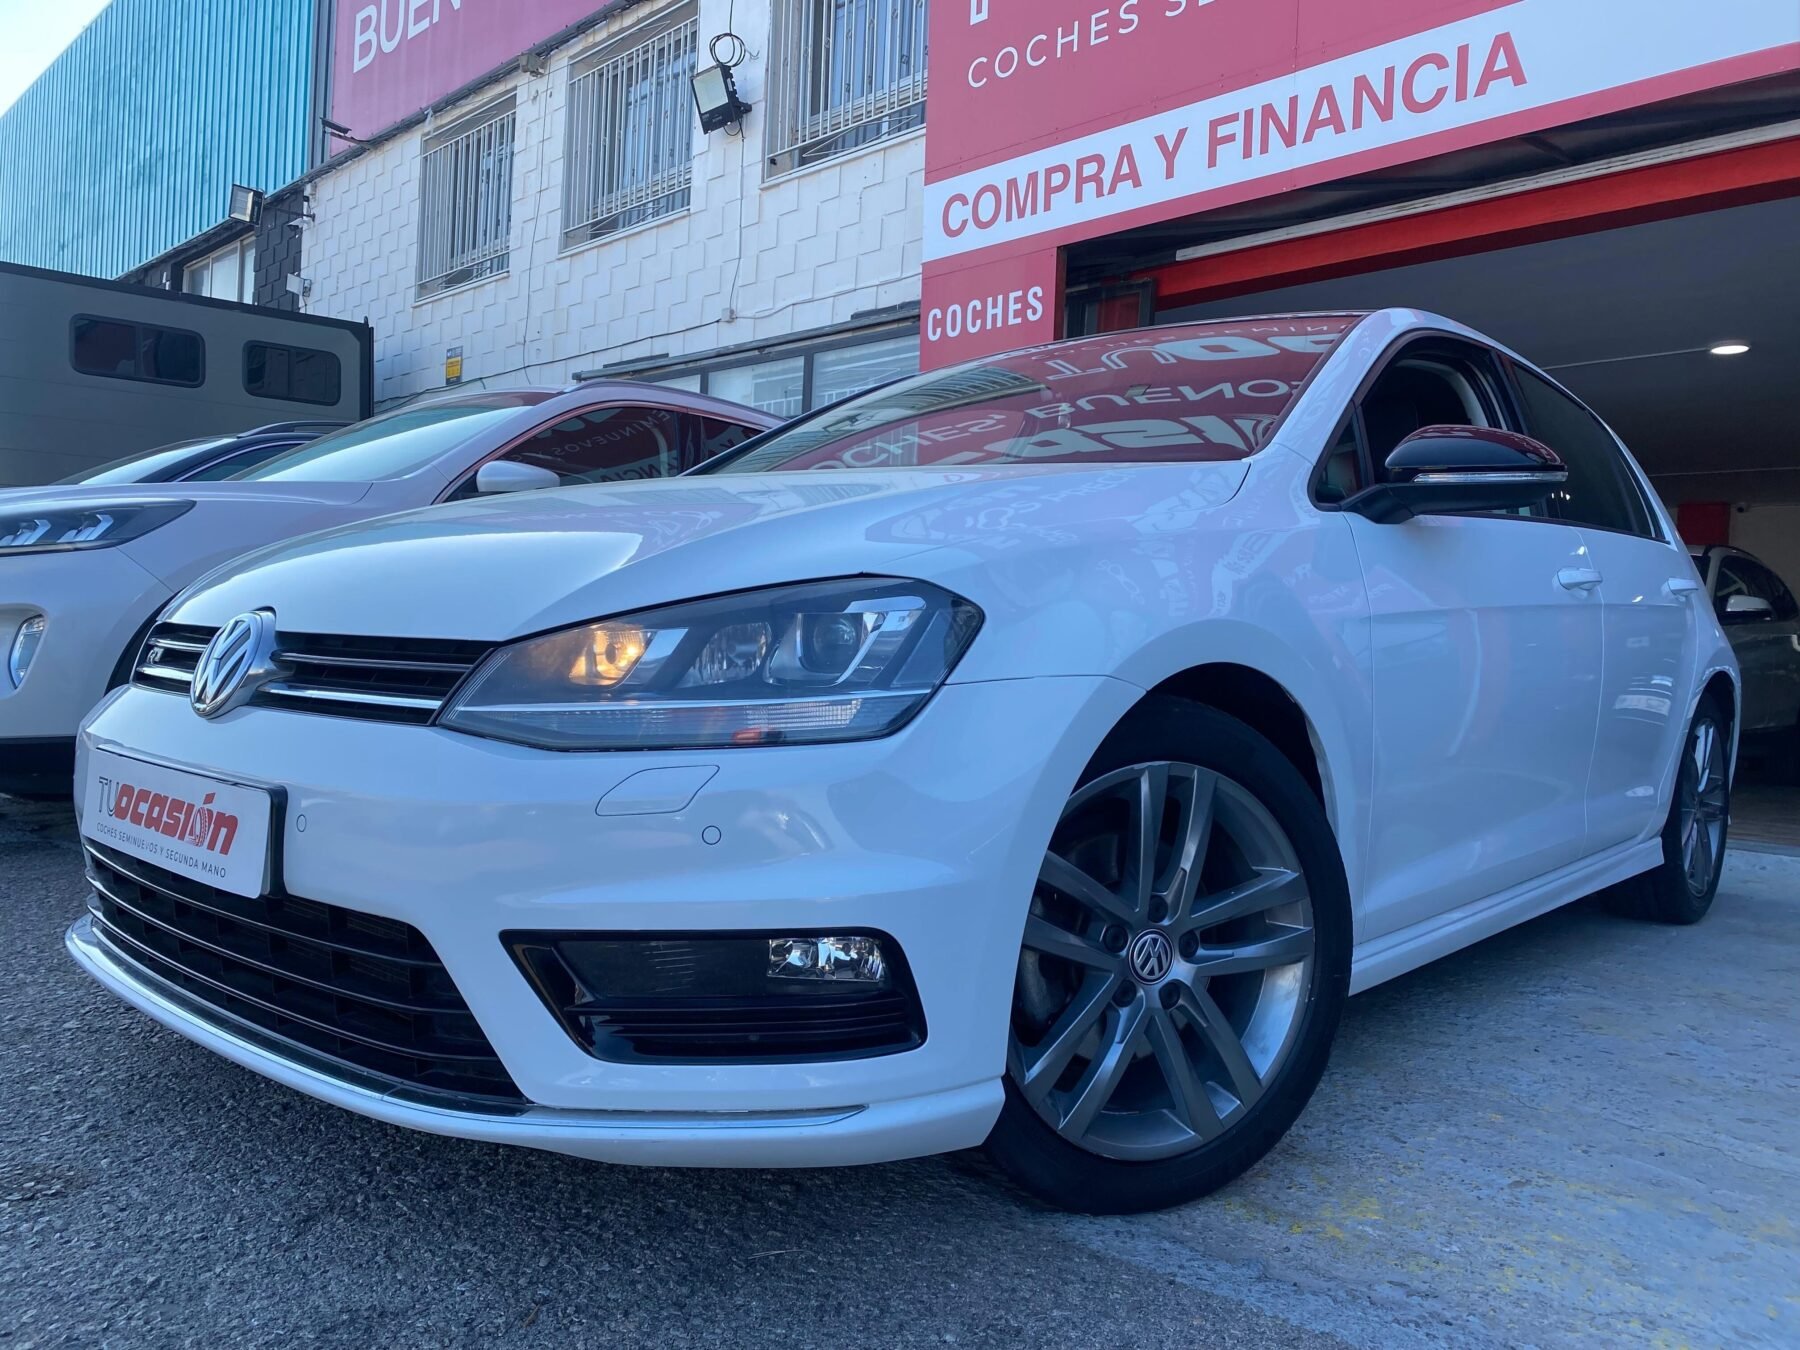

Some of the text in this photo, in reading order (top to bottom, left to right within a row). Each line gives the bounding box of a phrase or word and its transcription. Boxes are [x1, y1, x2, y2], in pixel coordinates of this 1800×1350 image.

[967, 0, 1139, 88] COCHES
[942, 31, 1528, 238] COMPRA Y FINANCIA
[927, 286, 1044, 341] COCHES
[96, 822, 227, 879] COCHES SEMINUEVOS Y SEGUNDA MANO
